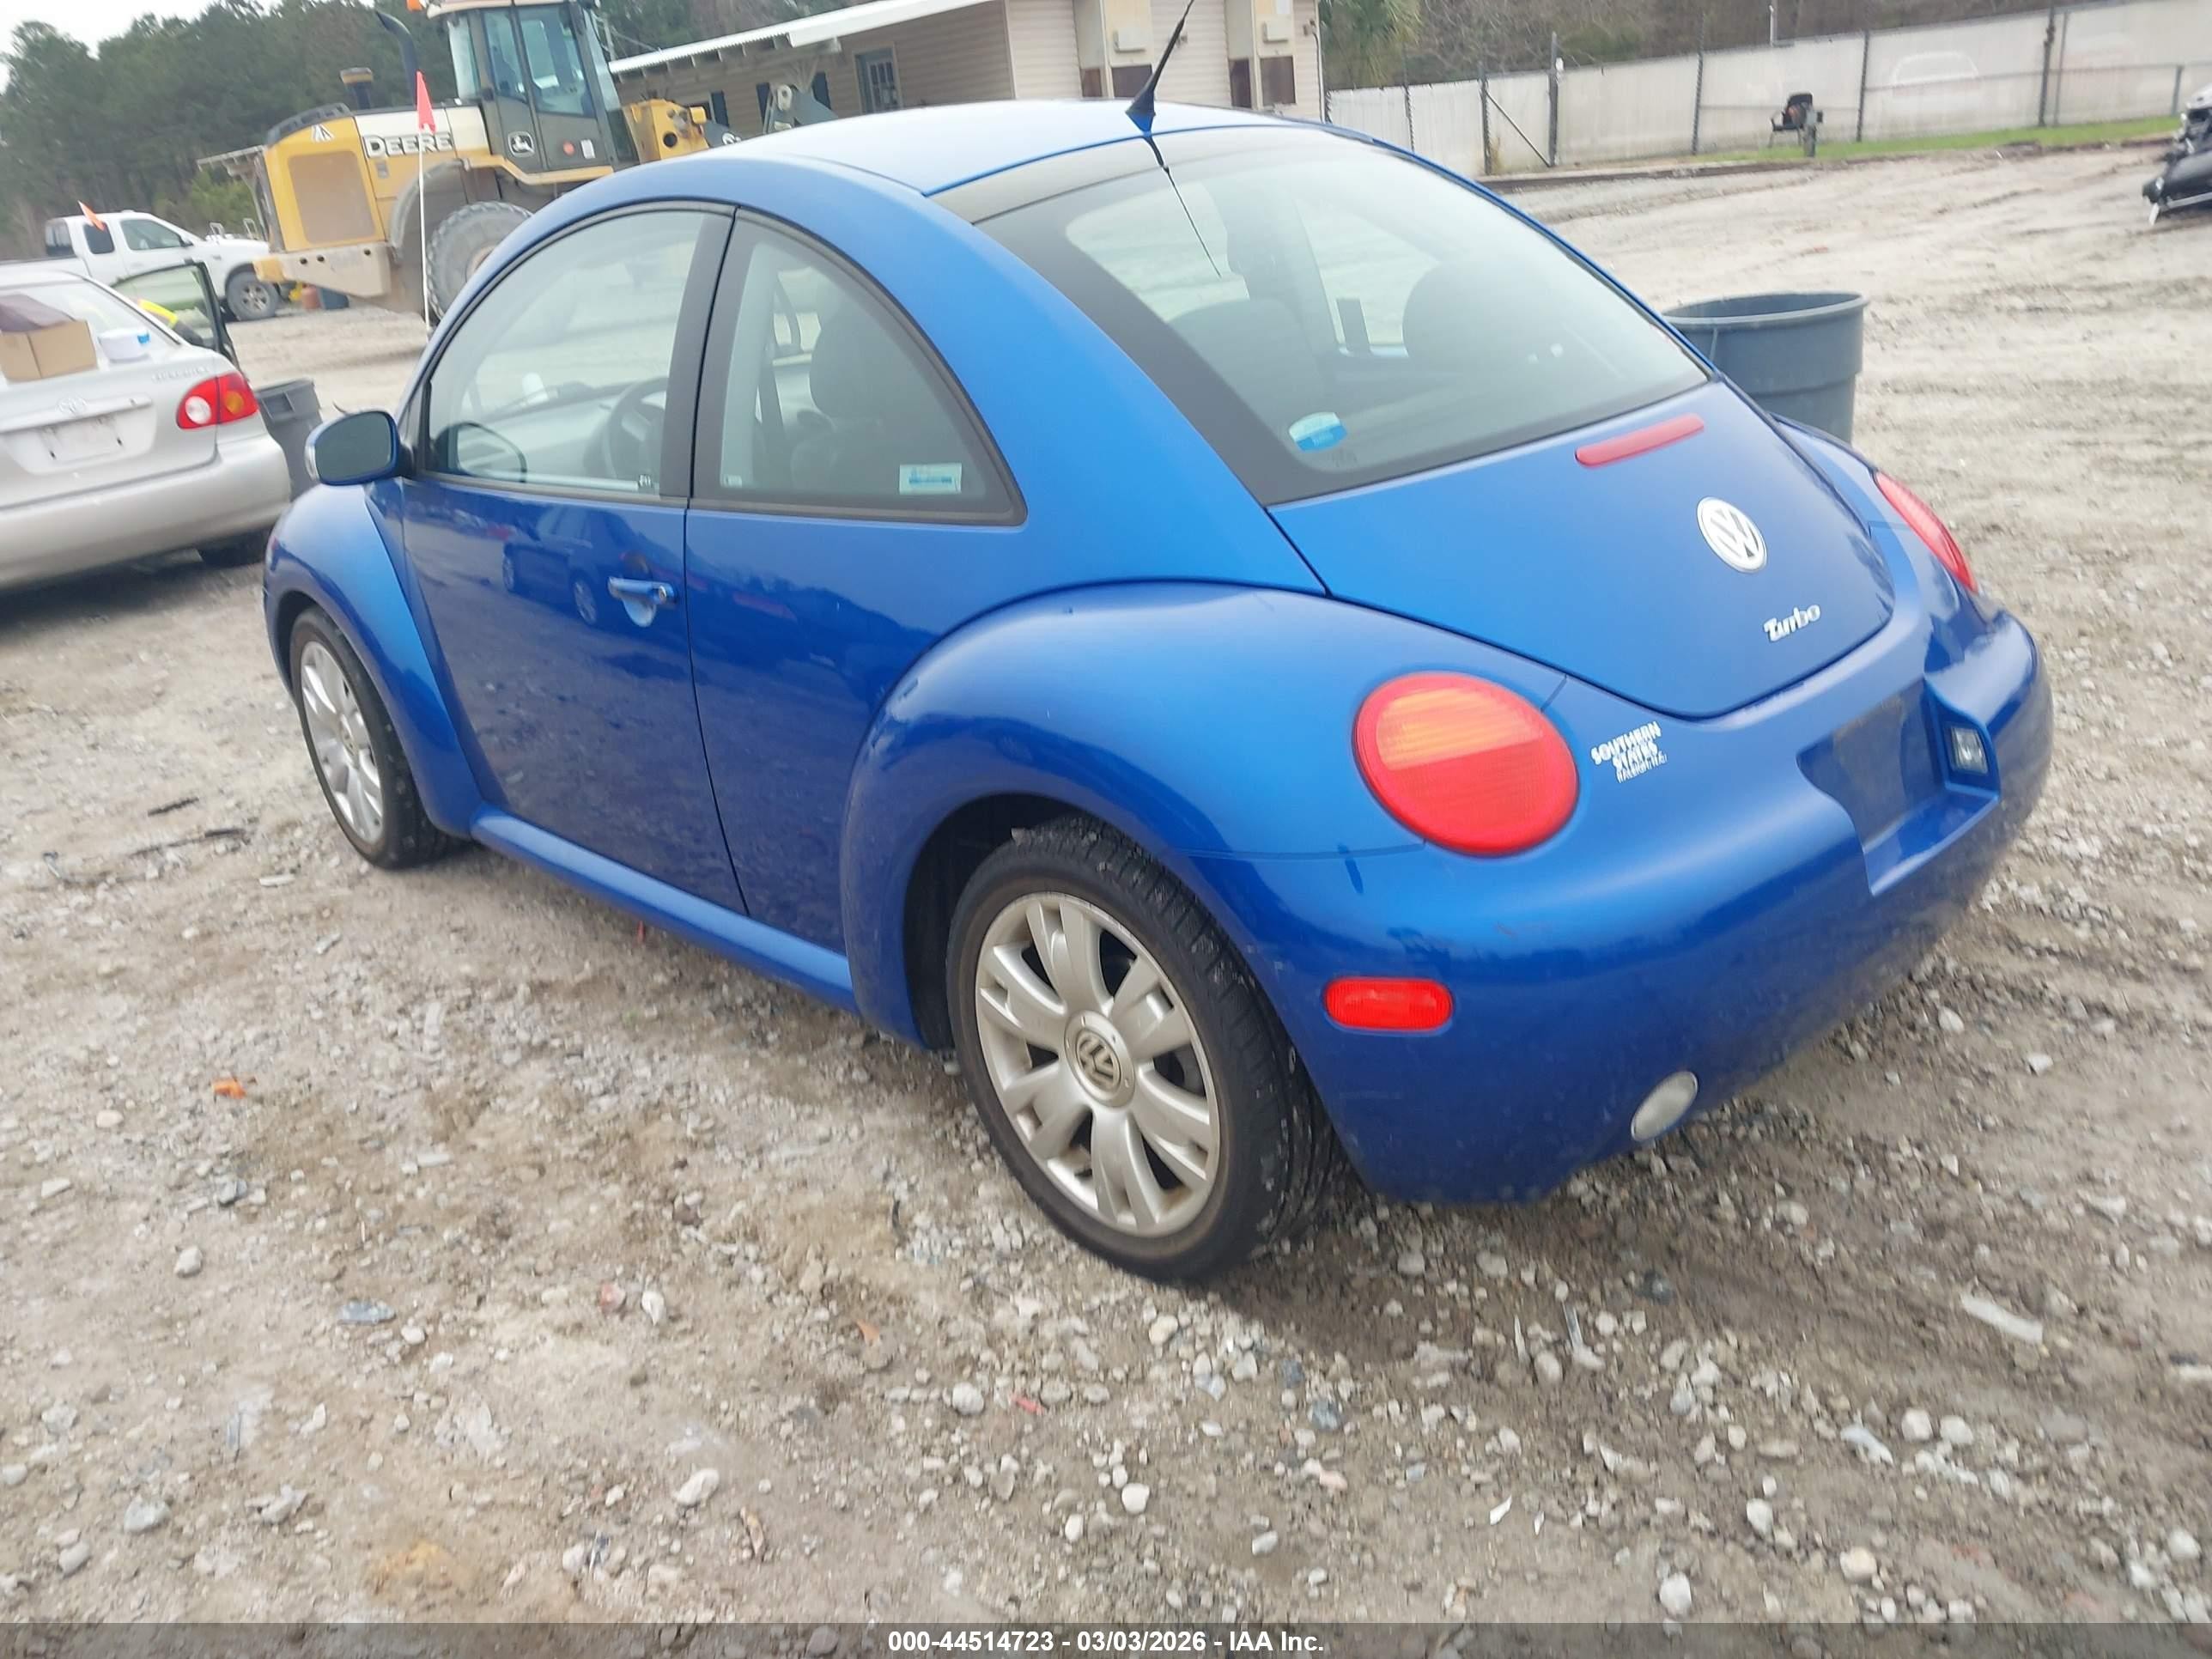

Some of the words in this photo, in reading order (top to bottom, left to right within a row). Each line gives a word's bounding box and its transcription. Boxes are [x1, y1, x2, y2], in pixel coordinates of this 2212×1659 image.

[362, 132, 454, 158] DEERE
[1700, 498, 1765, 571] VW
[1763, 604, 1821, 642] Turbo
[1590, 720, 1662, 765] SOUTHERN
